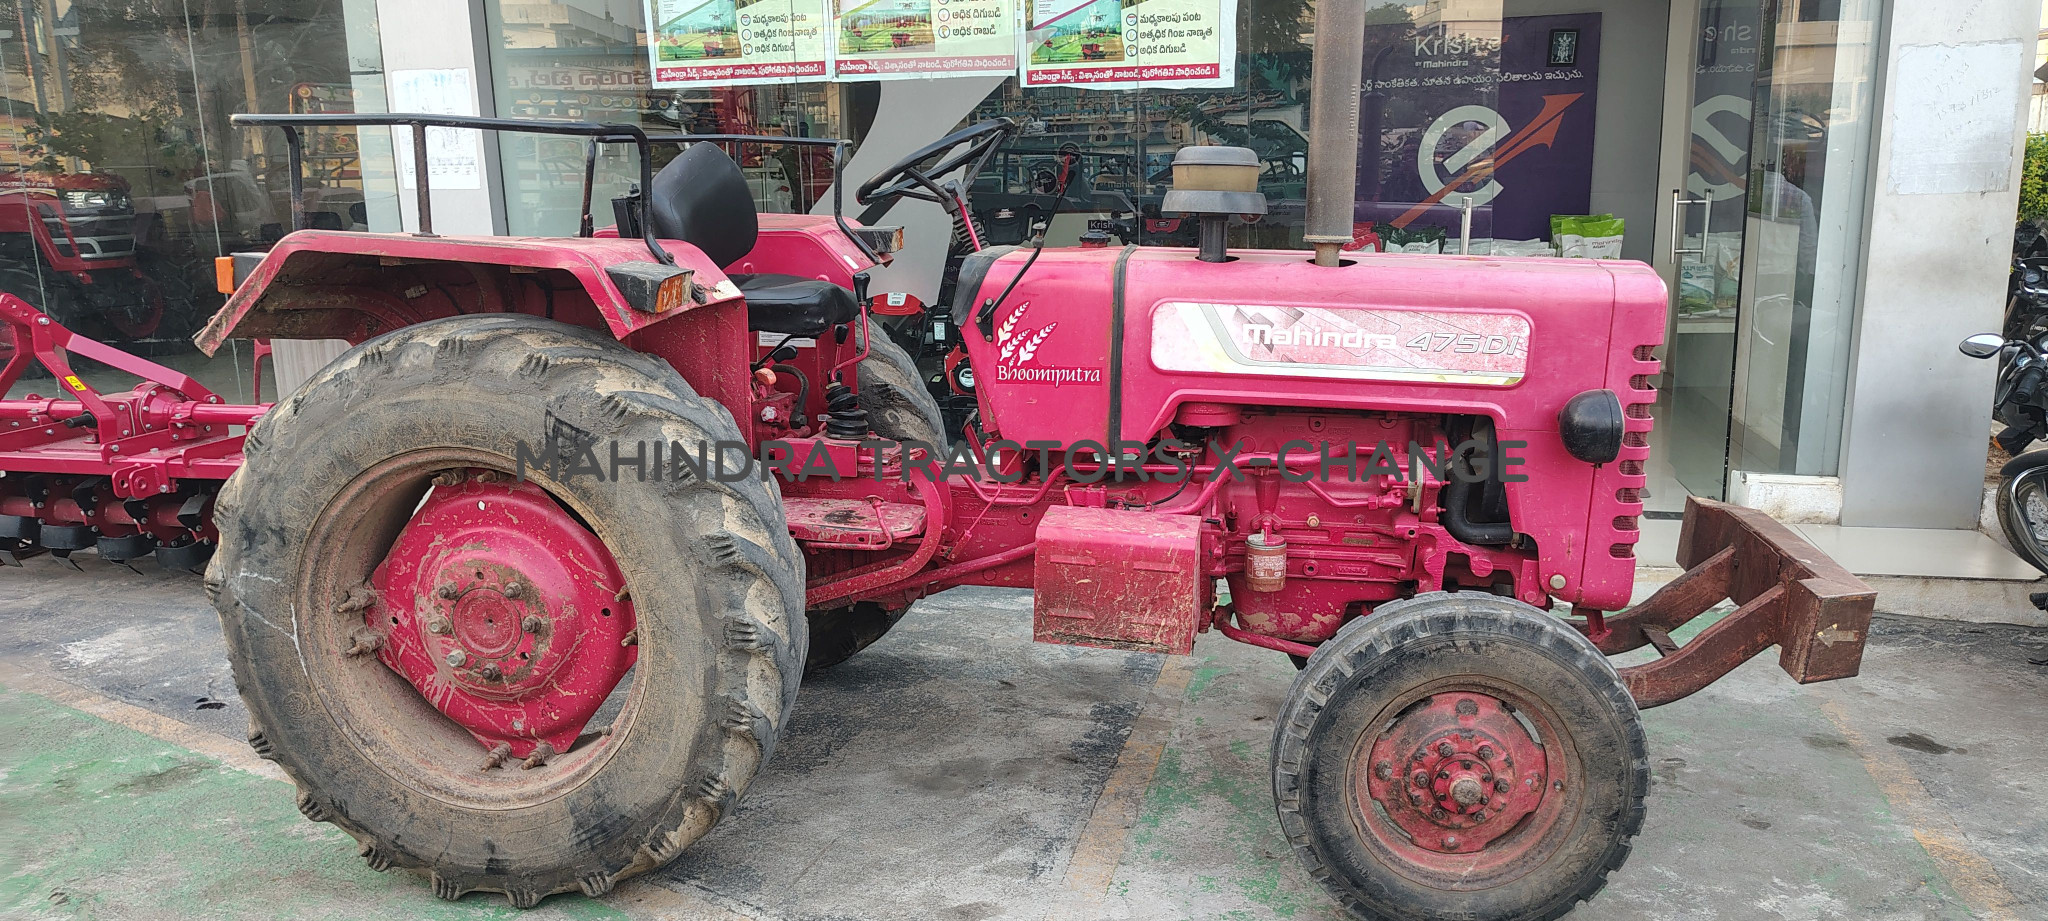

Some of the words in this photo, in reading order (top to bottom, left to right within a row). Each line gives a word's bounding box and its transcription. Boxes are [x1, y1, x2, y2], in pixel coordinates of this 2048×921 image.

[752, 13, 789, 27] మధ్యకాలపు
[952, 9, 971, 20] అధిక
[972, 6, 1001, 18] దిగుబడి
[1139, 13, 1181, 27] మధ్యకాలపు
[1182, 13, 1201, 22] పంట
[753, 29, 777, 41] అత్యధిక
[953, 26, 971, 38] అధిక
[973, 24, 996, 36] రాబడి
[1139, 28, 1166, 42] అత్యధిక
[1167, 28, 1184, 38] గింజ
[1186, 26, 1213, 41] నాణ్యత
[755, 43, 771, 54] అధిక
[1139, 44, 1158, 56] అధిక
[1159, 42, 1186, 53] దిగుబడి
[839, 60, 868, 71] మహీంద్రా
[661, 71, 687, 80] మహీంద్రా
[1031, 71, 1061, 82] మహీంద్రా
[1374, 78, 1420, 90] సాంకేతికత.
[1422, 77, 1450, 87] నూతన
[1453, 75, 1493, 86] ఉపాయం.
[1544, 69, 1584, 83] ఇచ్చును.
[1242, 322, 1397, 350] Mahindra
[997, 364, 1100, 387] Bhoomiputra
